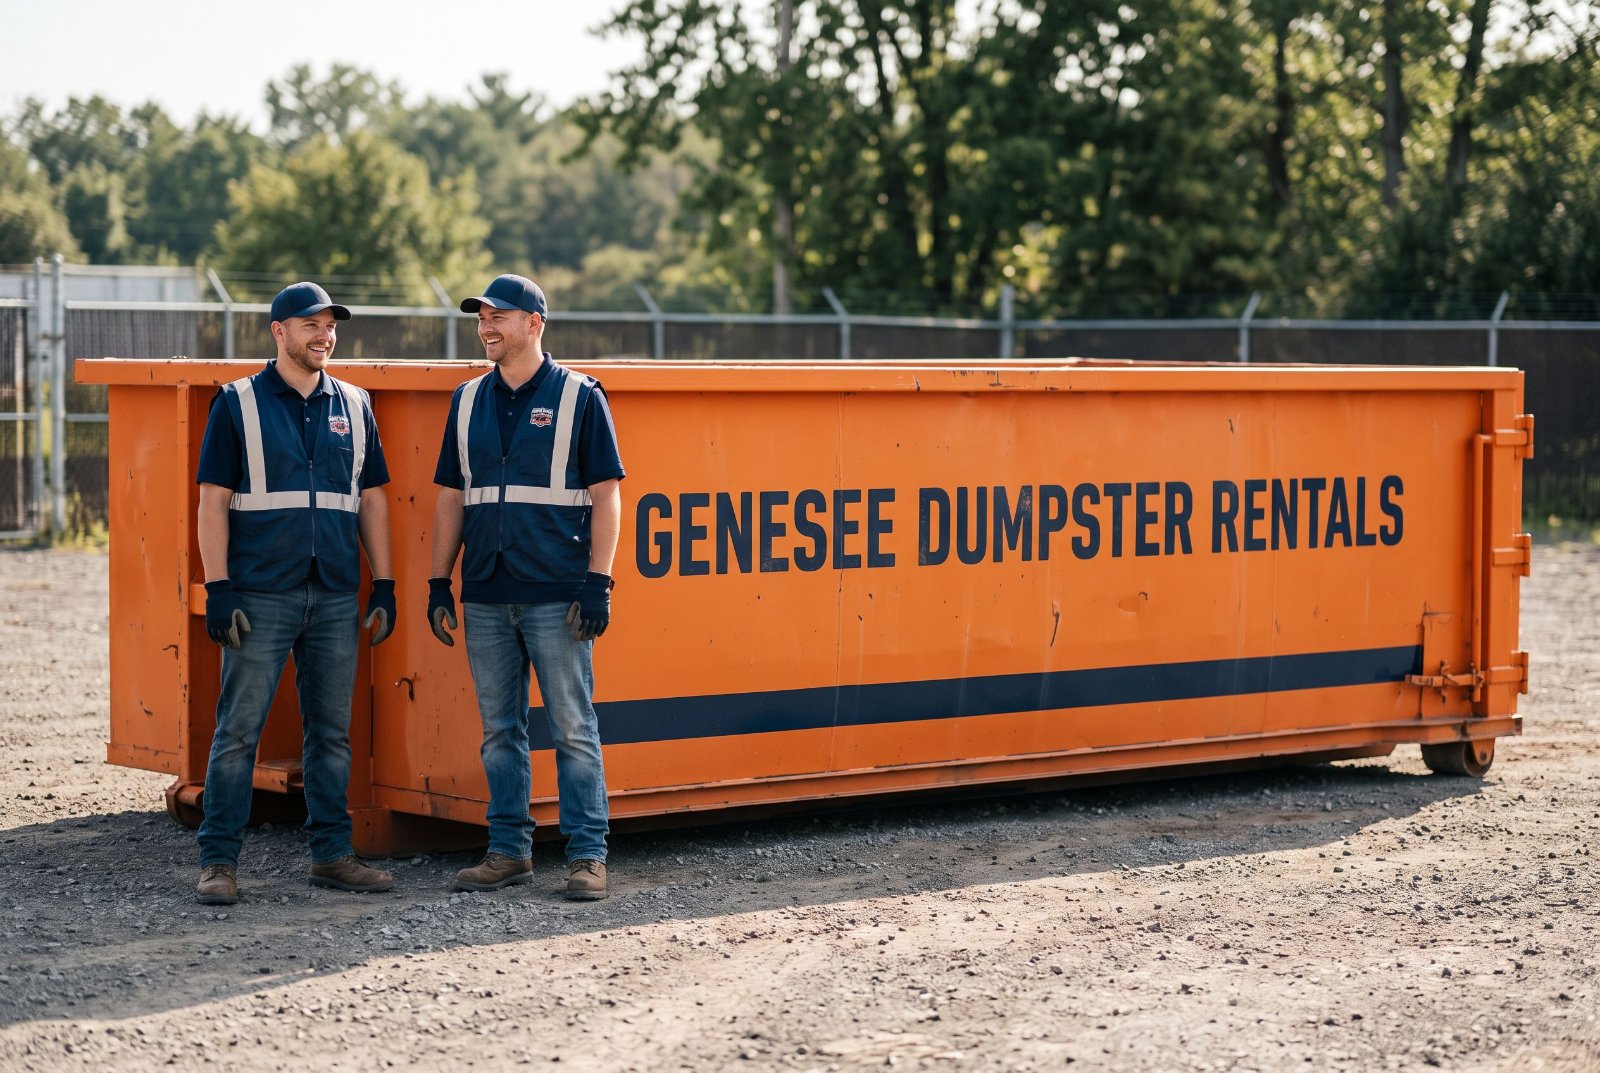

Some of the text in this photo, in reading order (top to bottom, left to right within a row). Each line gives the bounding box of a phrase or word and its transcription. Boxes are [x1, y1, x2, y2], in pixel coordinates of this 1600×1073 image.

[635, 475, 1404, 579] GENESEE DUMPSTER RENTALS
